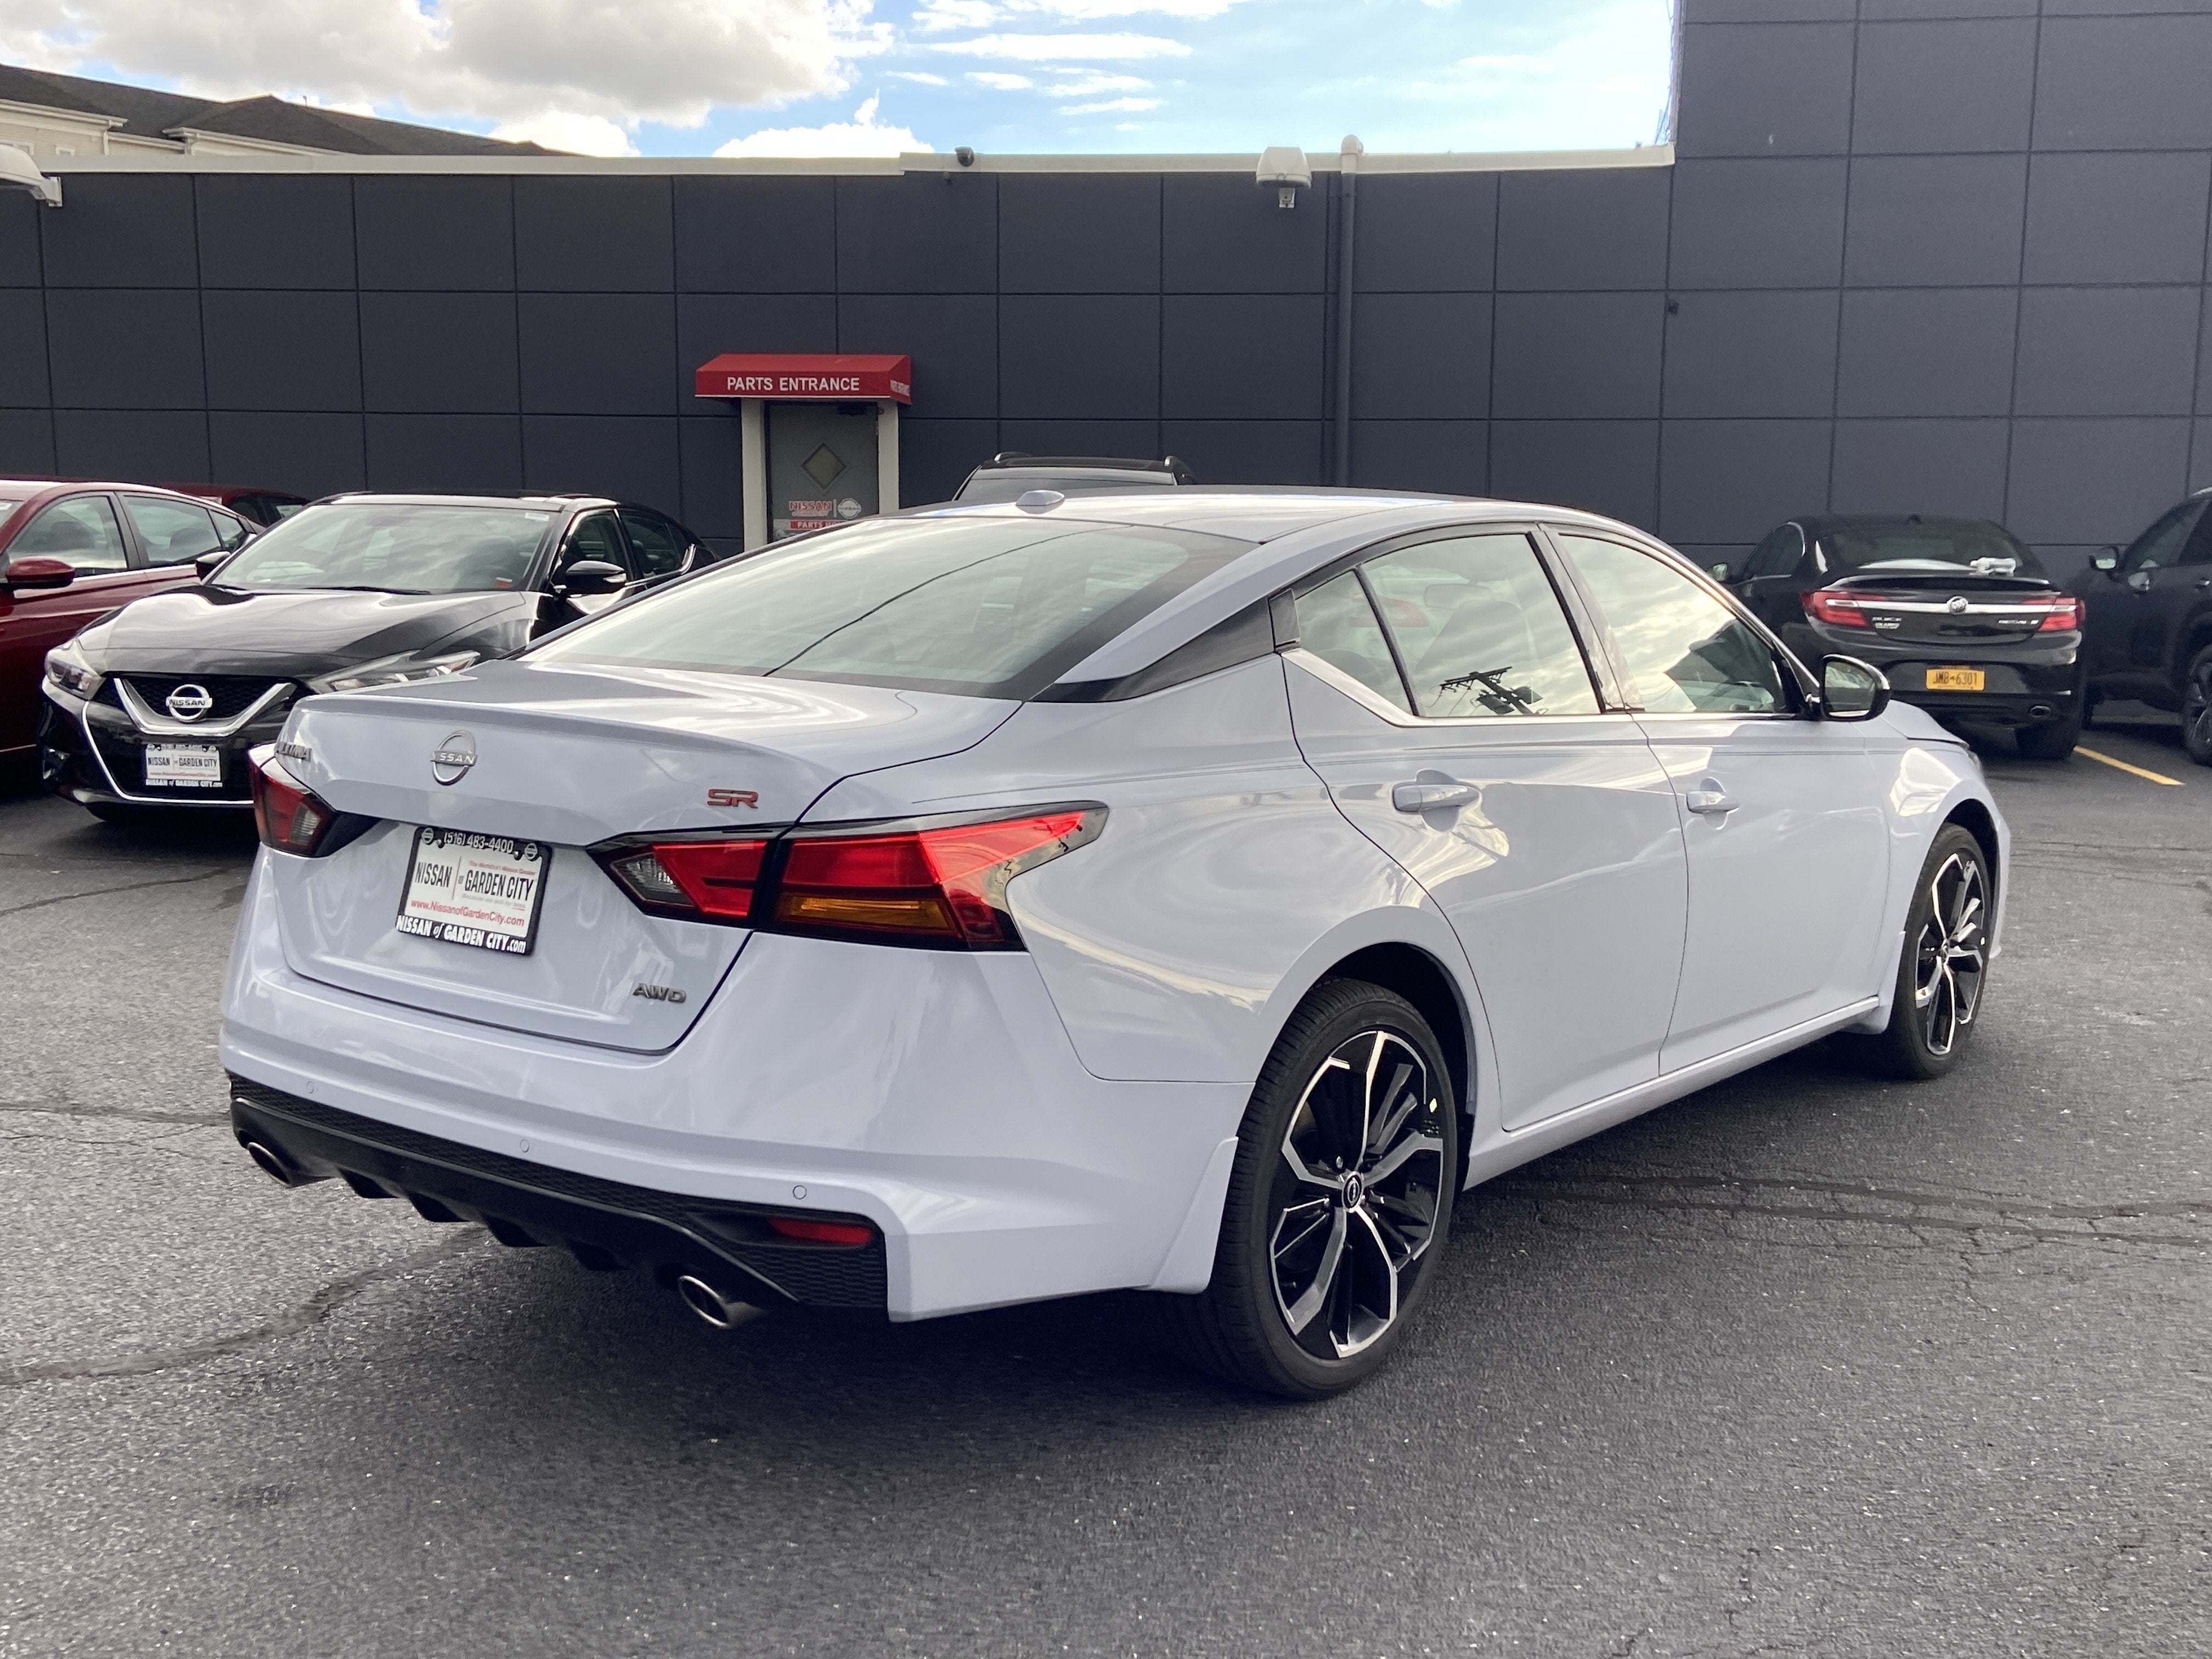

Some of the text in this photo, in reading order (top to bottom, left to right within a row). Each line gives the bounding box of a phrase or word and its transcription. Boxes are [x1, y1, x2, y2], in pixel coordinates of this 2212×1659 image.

[727, 377, 860, 391] PARTS ENTRANCE
[790, 502, 832, 511] NISSAN
[1956, 672, 1977, 685] 6301
[148, 757, 217, 767] NISSAN GARDEN CITY
[432, 751, 476, 764] NSSAN
[707, 789, 759, 809] SR
[444, 832, 514, 853] (516) 483-4400
[414, 861, 452, 888] NISSAN
[465, 870, 506, 896] GARDEN
[506, 876, 534, 901] CITY
[396, 915, 527, 953] NISSAN of GARDEN CITY.com
[632, 983, 686, 1003] AWD
